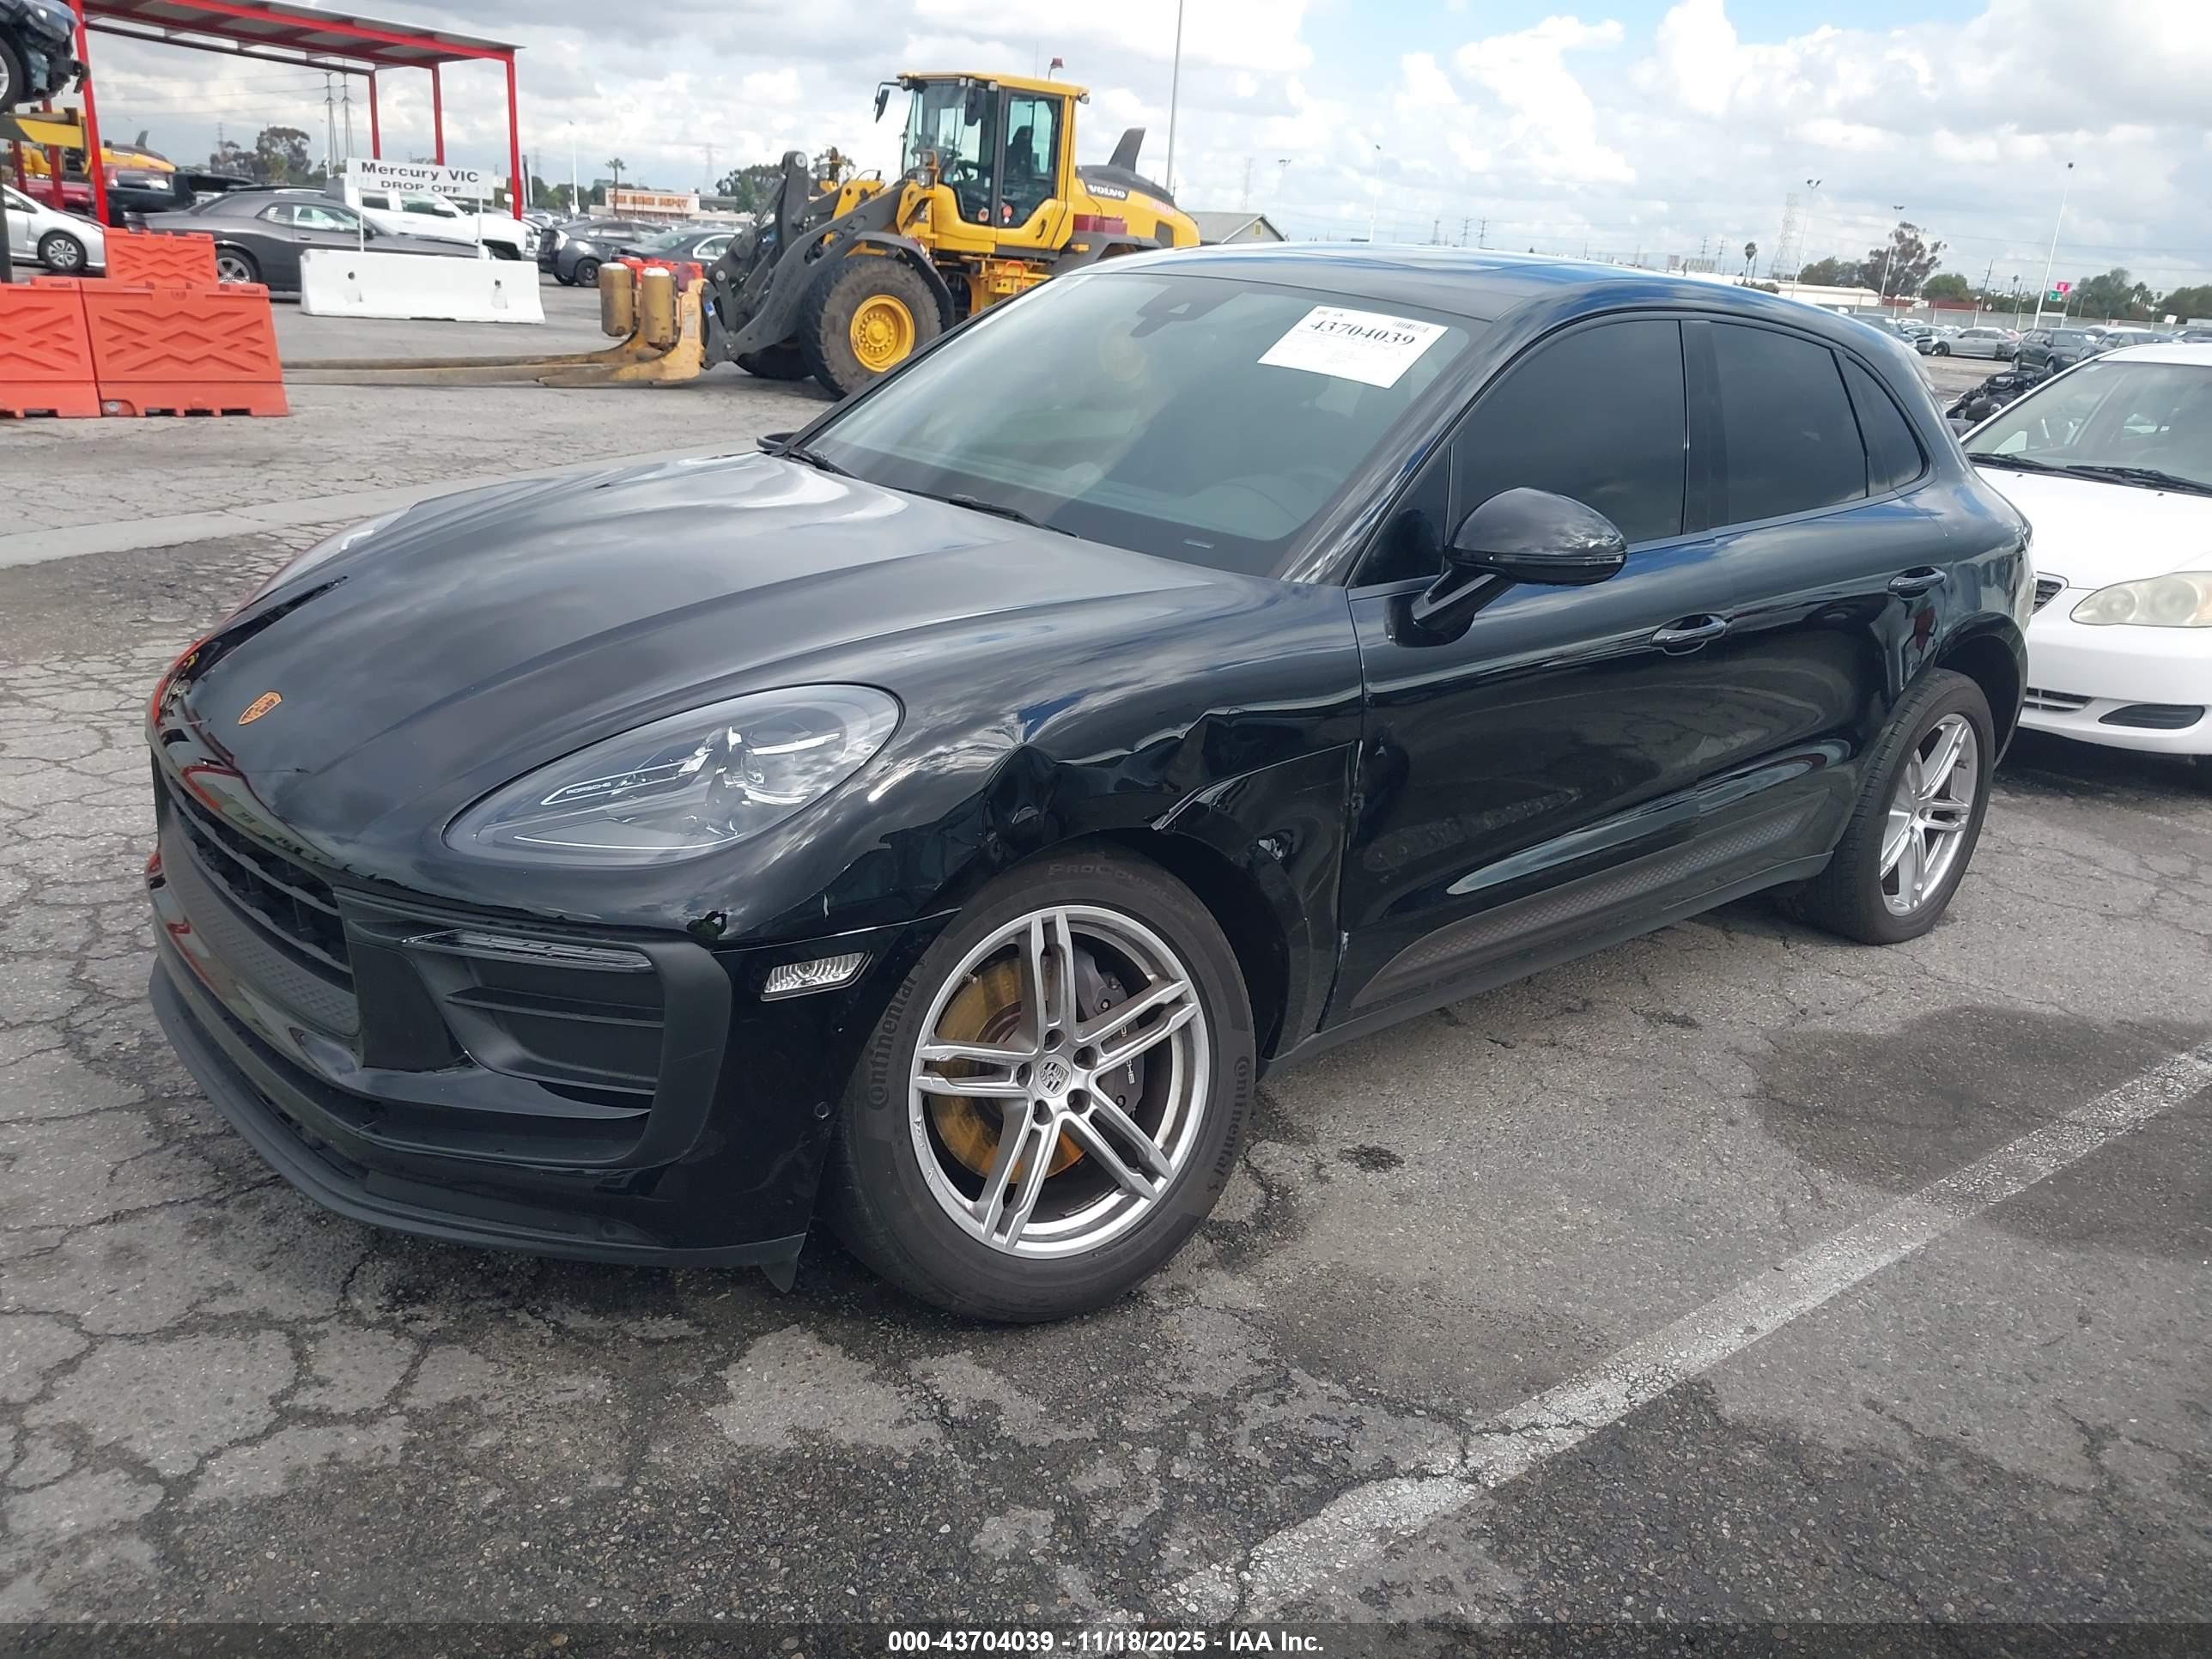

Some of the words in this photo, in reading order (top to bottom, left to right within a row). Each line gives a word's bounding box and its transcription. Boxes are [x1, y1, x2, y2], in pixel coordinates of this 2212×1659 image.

[362, 161, 440, 182] Mercury
[448, 169, 479, 183] VIC
[380, 180, 425, 191] DROP
[431, 184, 462, 193] OFF
[1086, 184, 1127, 198] VOLVO
[659, 197, 688, 208] DEPOT
[1310, 320, 1416, 345] 43704039
[866, 976, 919, 1110] Continental
[1214, 1055, 1250, 1176] Continental
